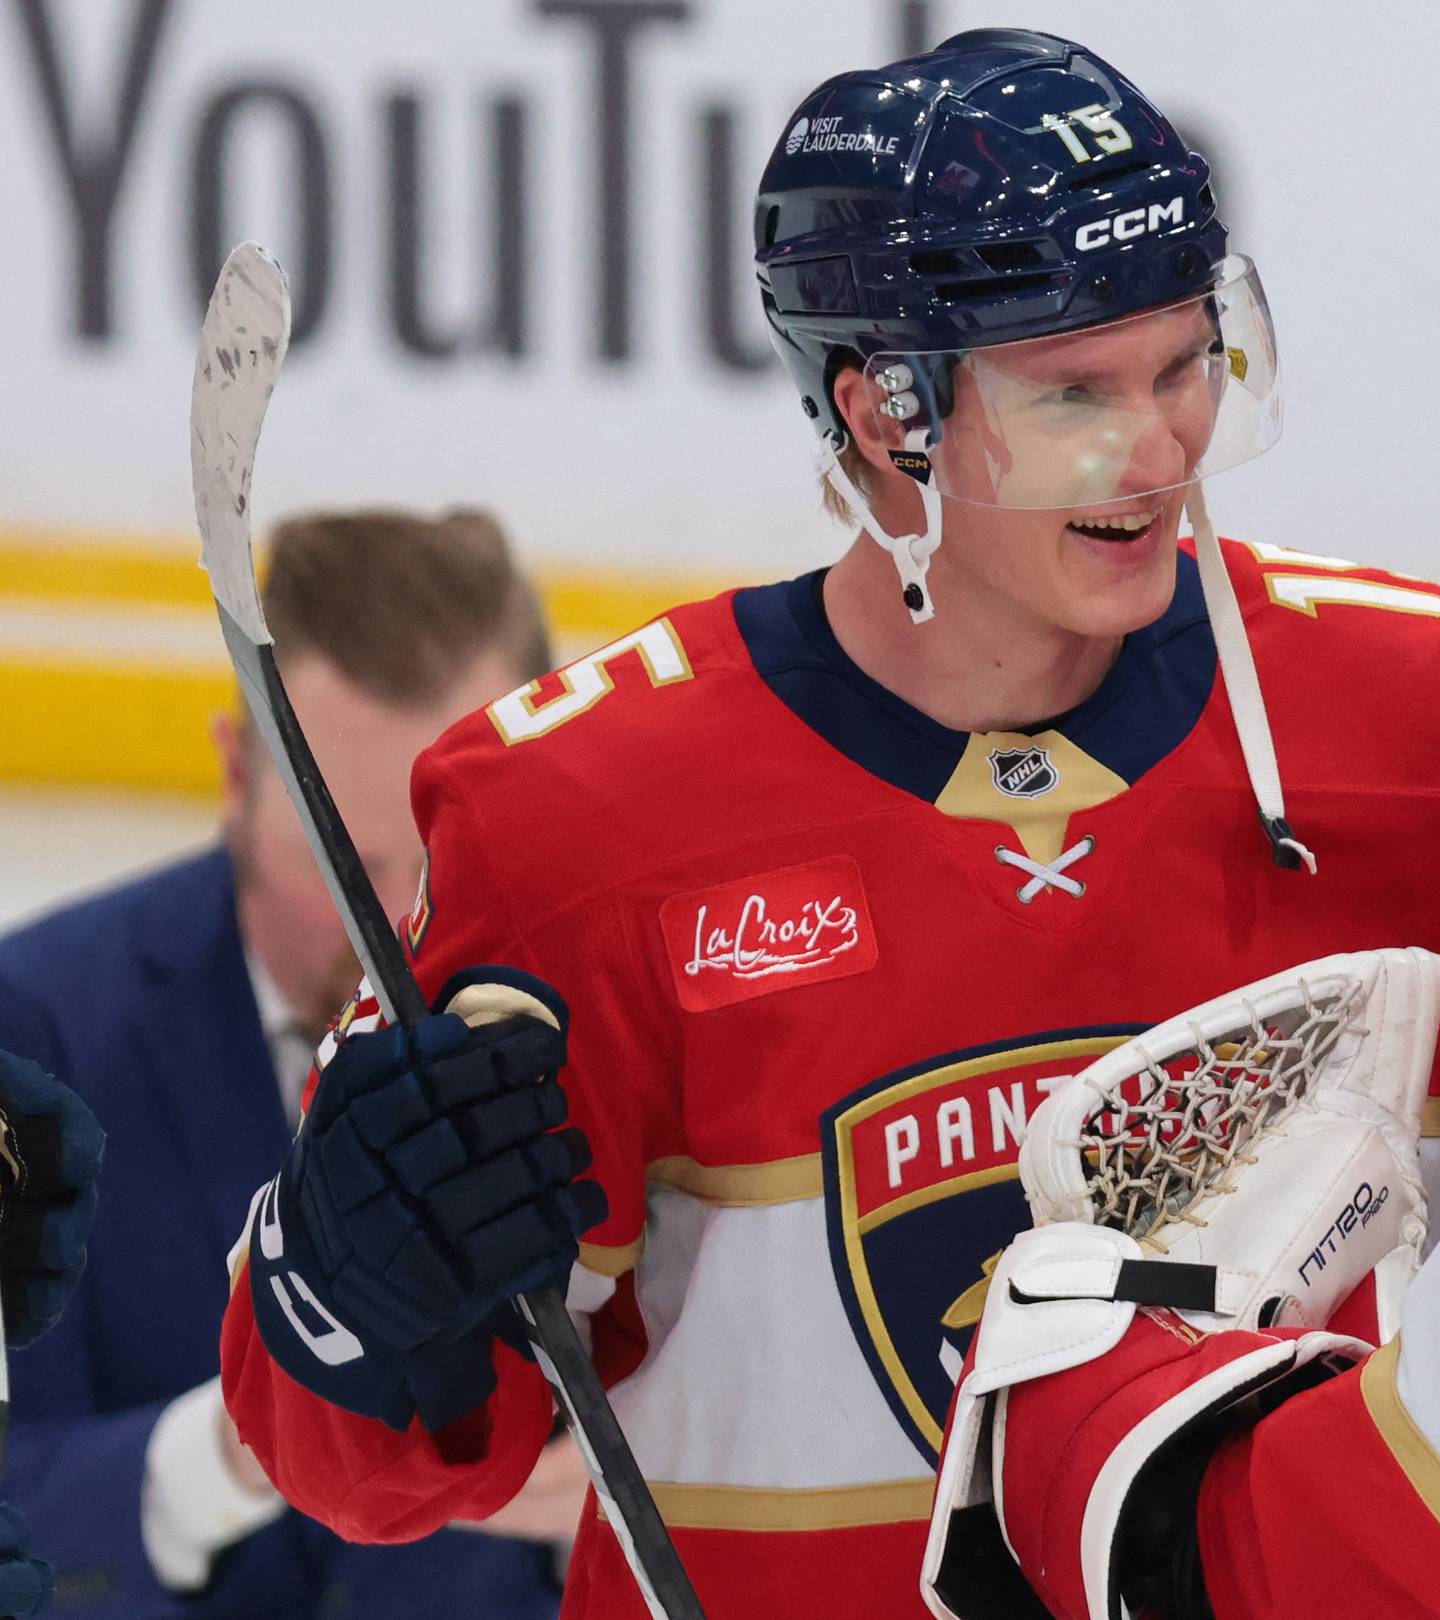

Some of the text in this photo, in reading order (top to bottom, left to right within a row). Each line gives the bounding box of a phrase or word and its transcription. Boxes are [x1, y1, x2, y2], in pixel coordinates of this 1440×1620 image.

[802, 133, 900, 155] LAUDERDALE
[811, 116, 843, 134] VISIT
[1039, 103, 1134, 164] 15
[1074, 196, 1184, 252] CCM
[893, 457, 930, 470] CCM
[1006, 758, 1042, 791] NHL
[1361, 1185, 1390, 1230] PRO
[1298, 1181, 1373, 1288] NITRO
